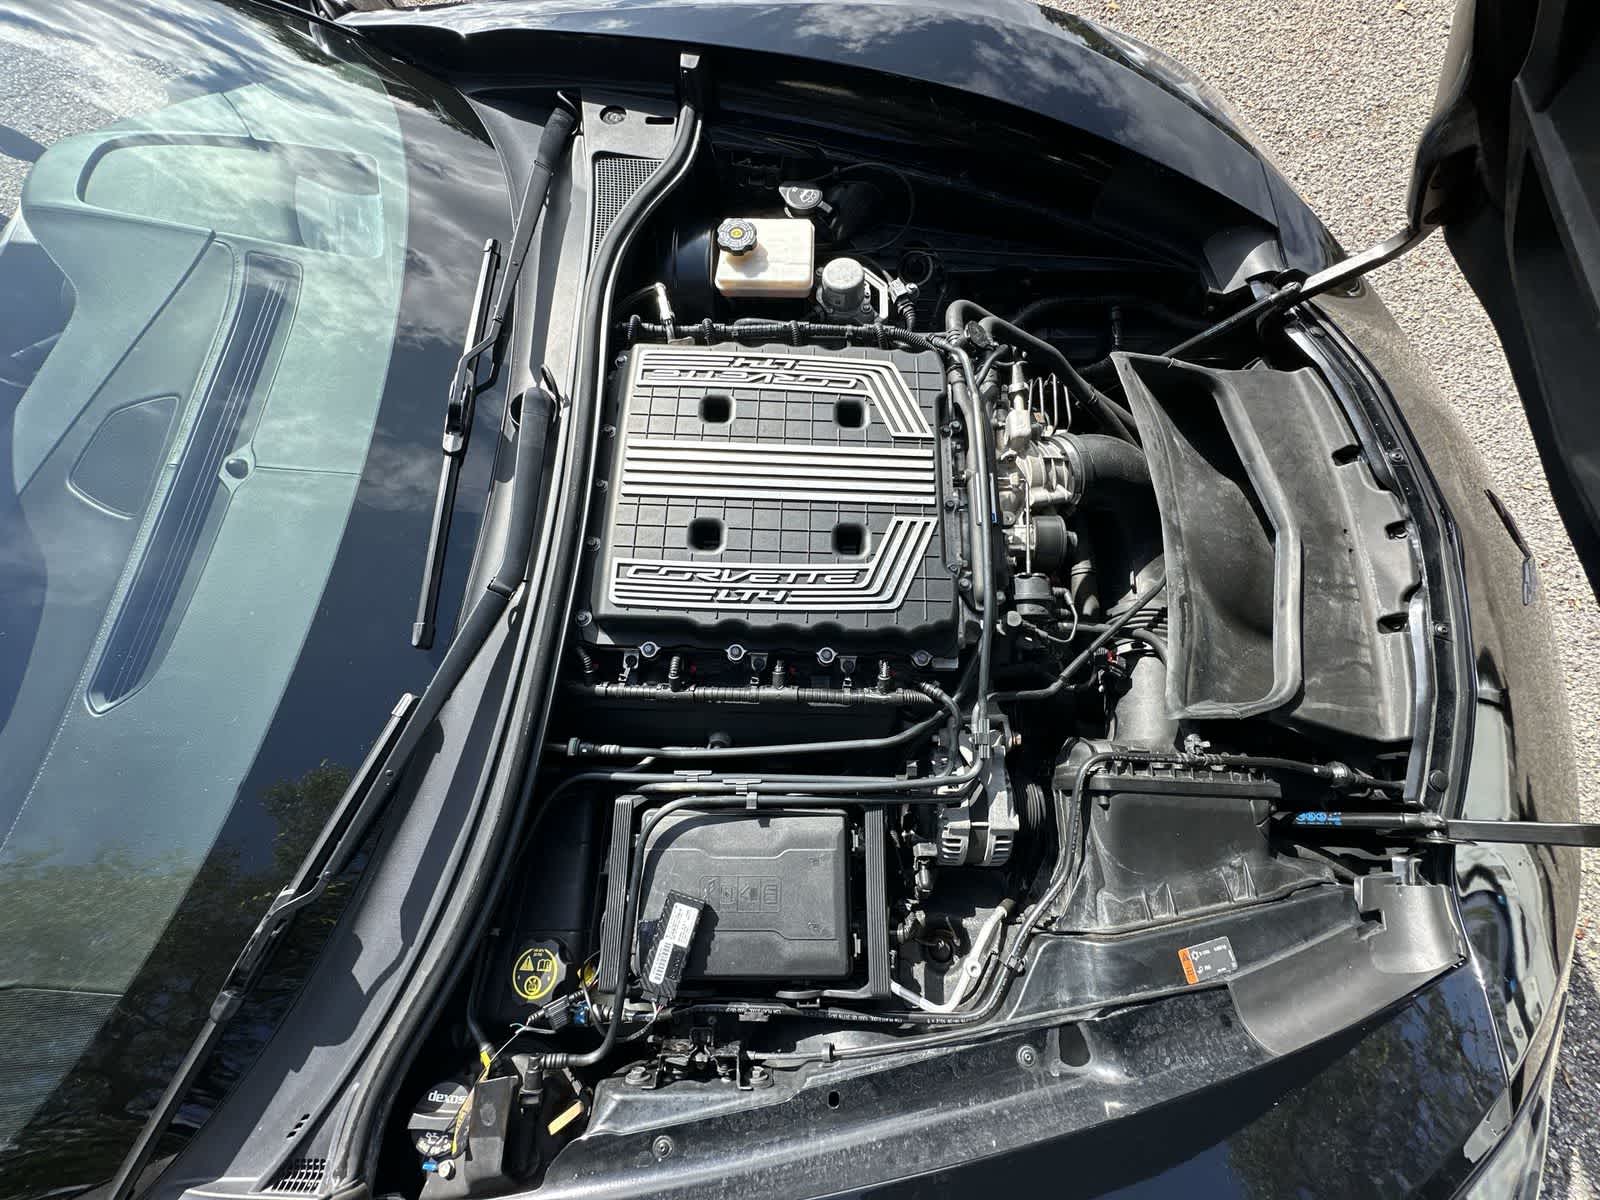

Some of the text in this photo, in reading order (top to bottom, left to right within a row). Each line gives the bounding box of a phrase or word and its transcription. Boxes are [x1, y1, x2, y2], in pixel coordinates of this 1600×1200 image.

[732, 357, 796, 370] LT4
[652, 369, 857, 388] CORVETTE
[627, 566, 859, 584] CORVETTE
[717, 588, 787, 603] LT4
[428, 1090, 468, 1105] dexos
